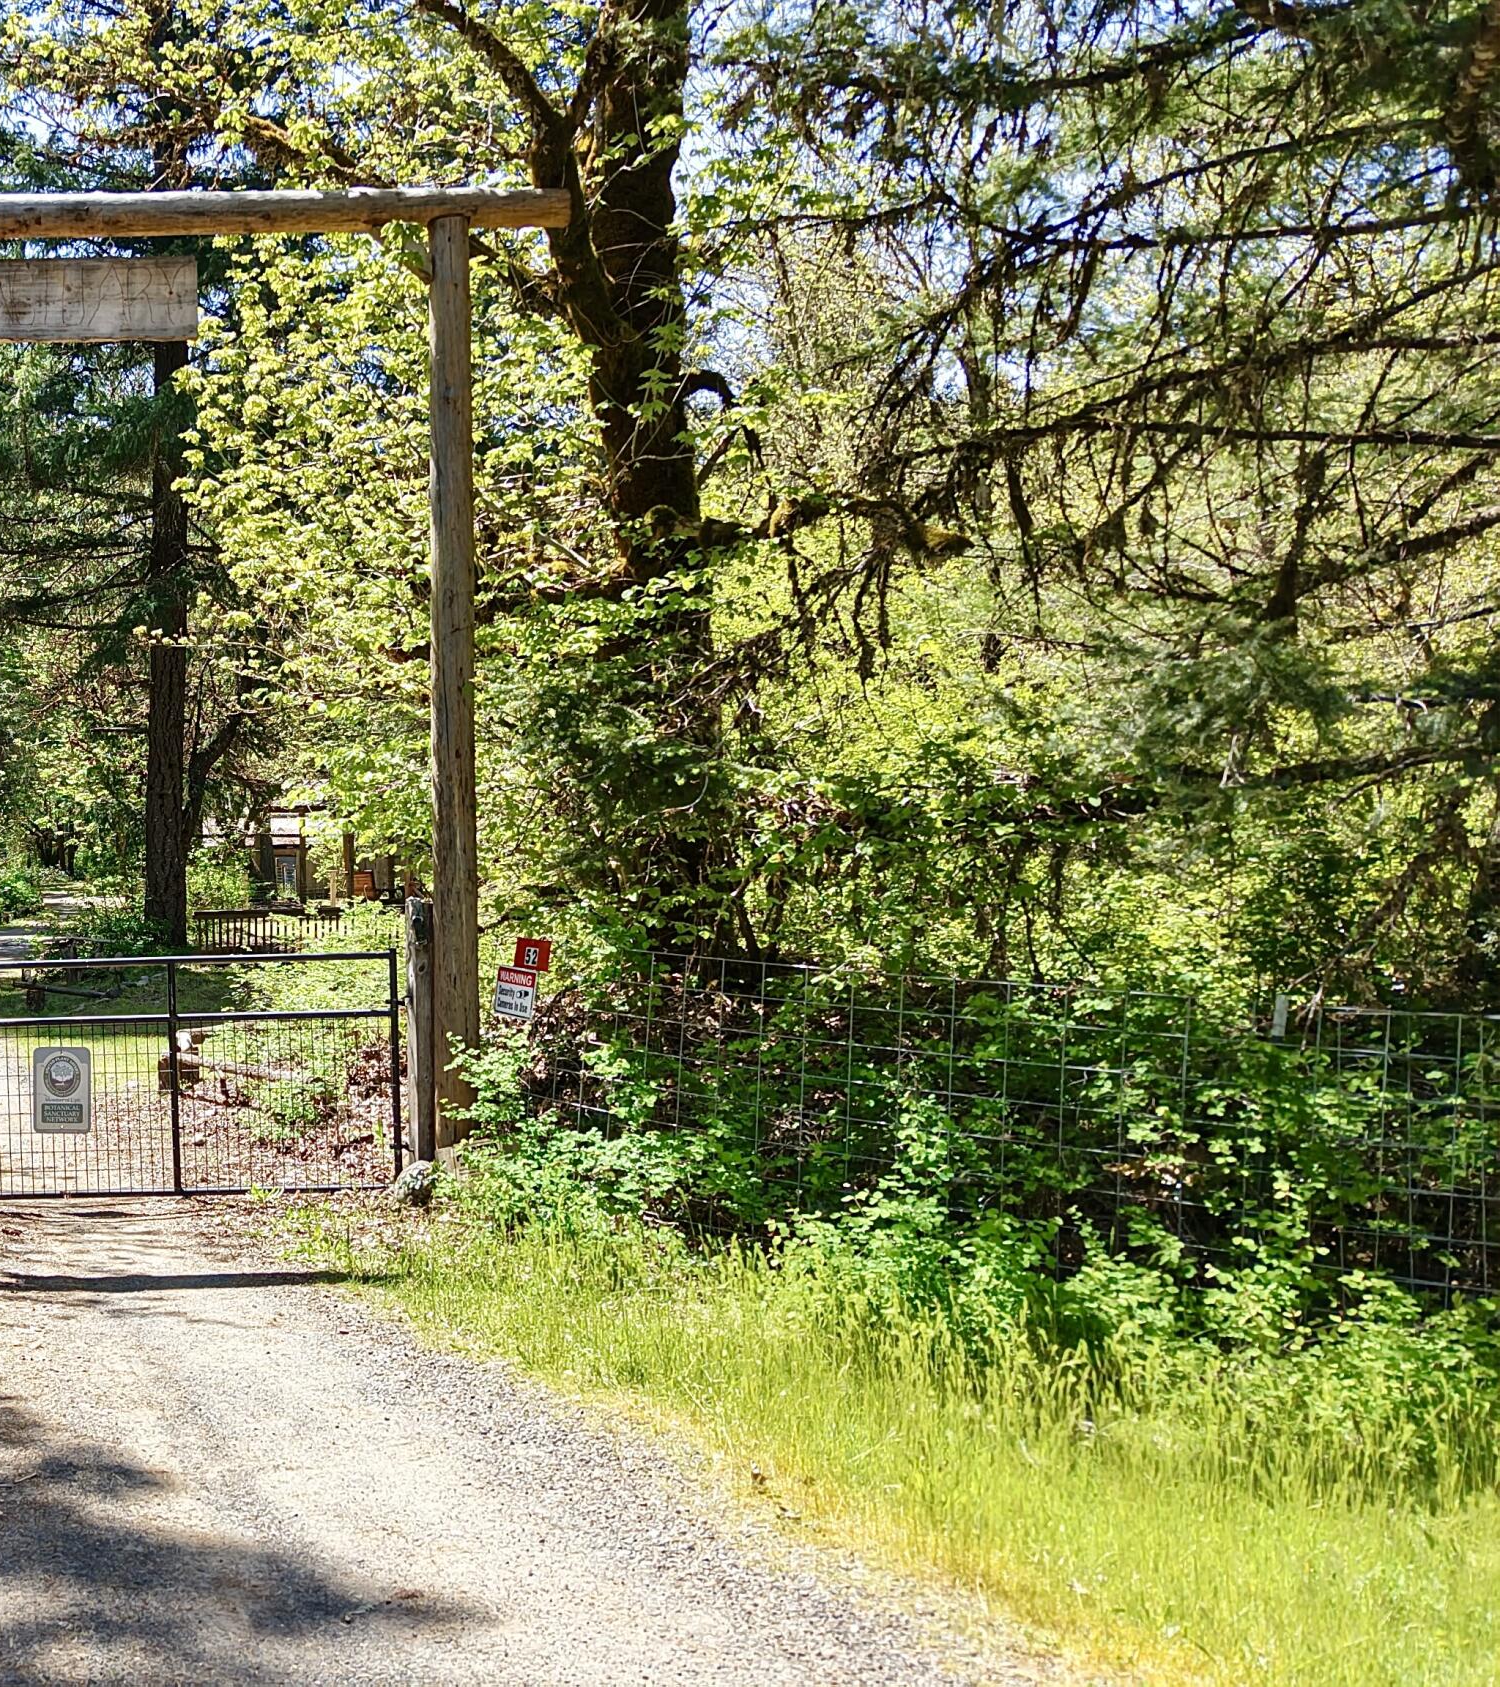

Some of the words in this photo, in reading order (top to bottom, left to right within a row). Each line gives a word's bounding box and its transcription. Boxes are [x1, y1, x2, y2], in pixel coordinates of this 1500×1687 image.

[525, 948, 538, 965] 52
[500, 970, 532, 986] WARNING
[498, 985, 515, 1001] Security
[498, 997, 514, 1010] Cameras
